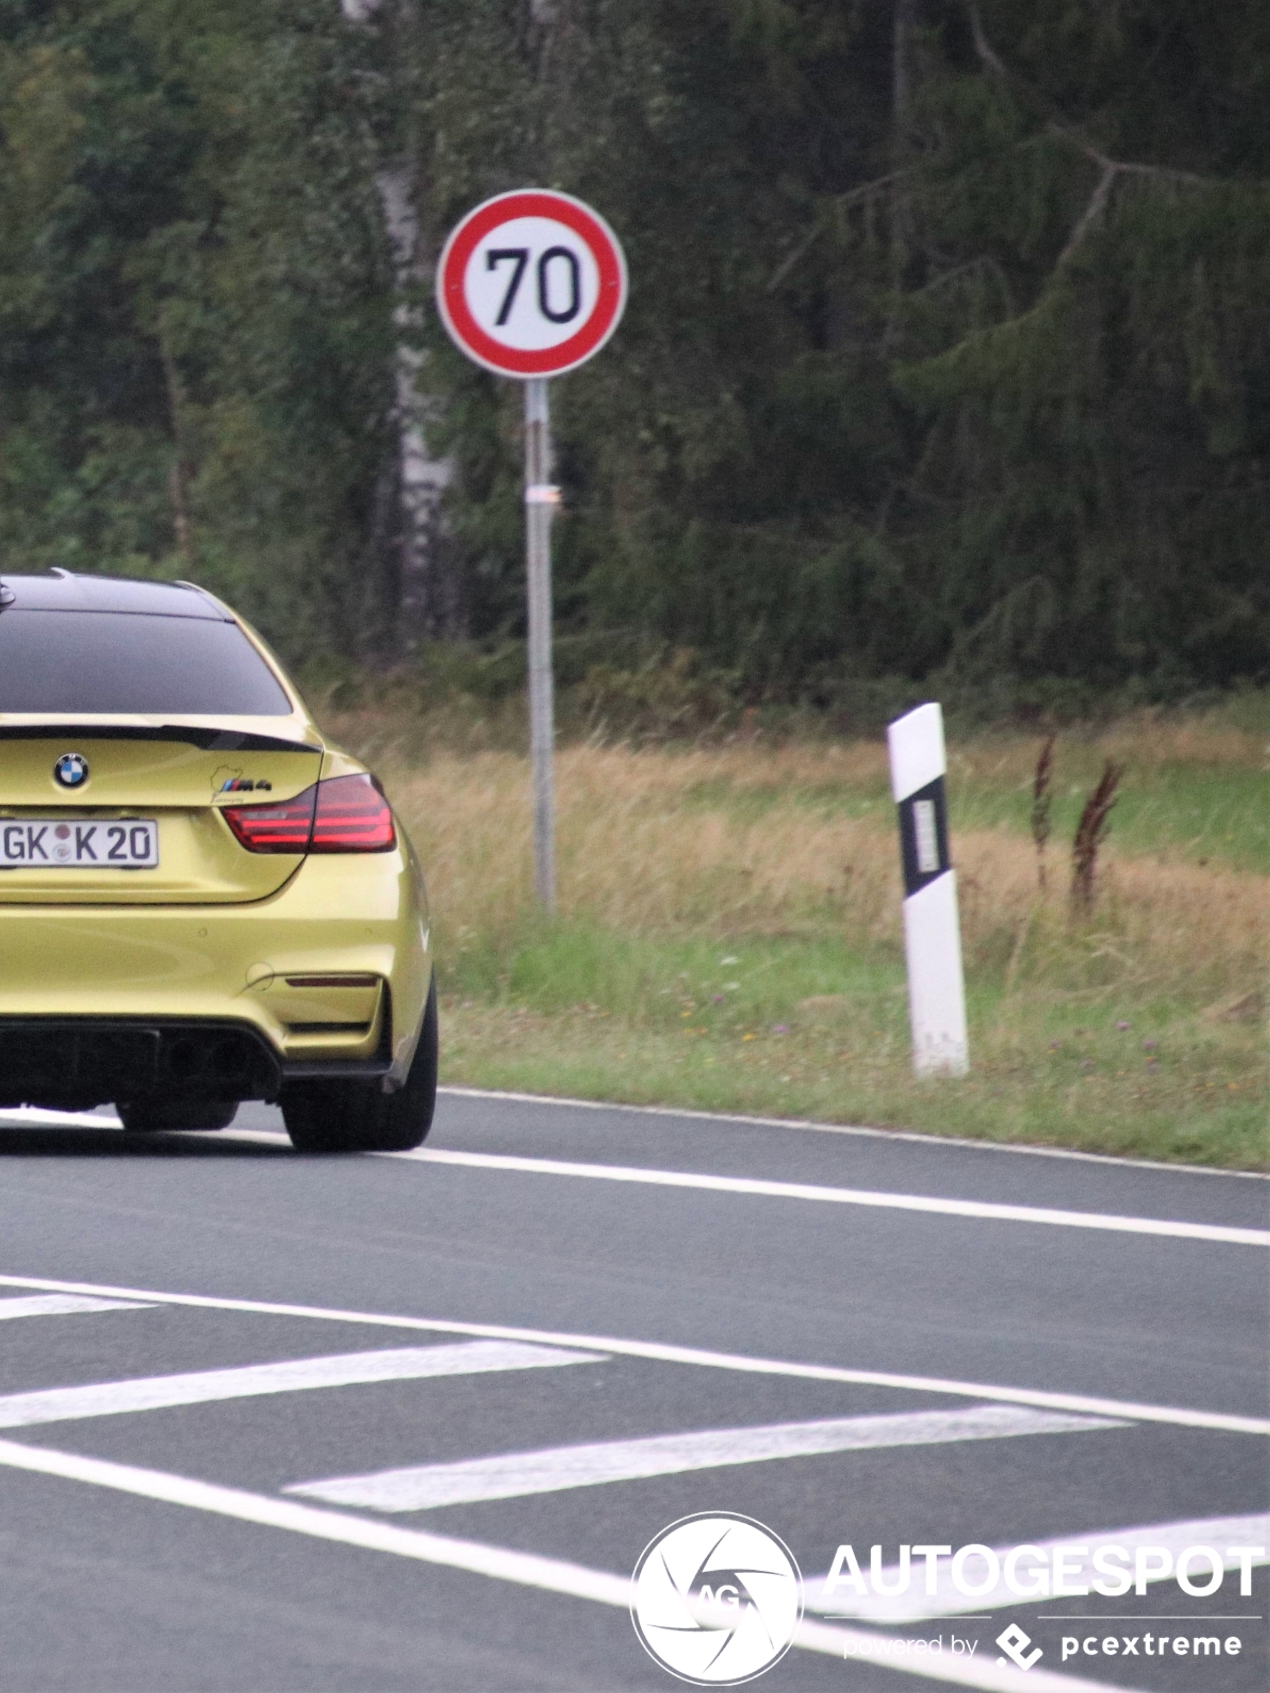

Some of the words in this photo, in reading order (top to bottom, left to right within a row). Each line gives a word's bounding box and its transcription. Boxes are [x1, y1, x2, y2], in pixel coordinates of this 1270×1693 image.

[486, 245, 581, 326] 70
[233, 778, 272, 792] M4
[3, 826, 48, 860] GK
[75, 826, 98, 860] K
[107, 826, 151, 860] 20
